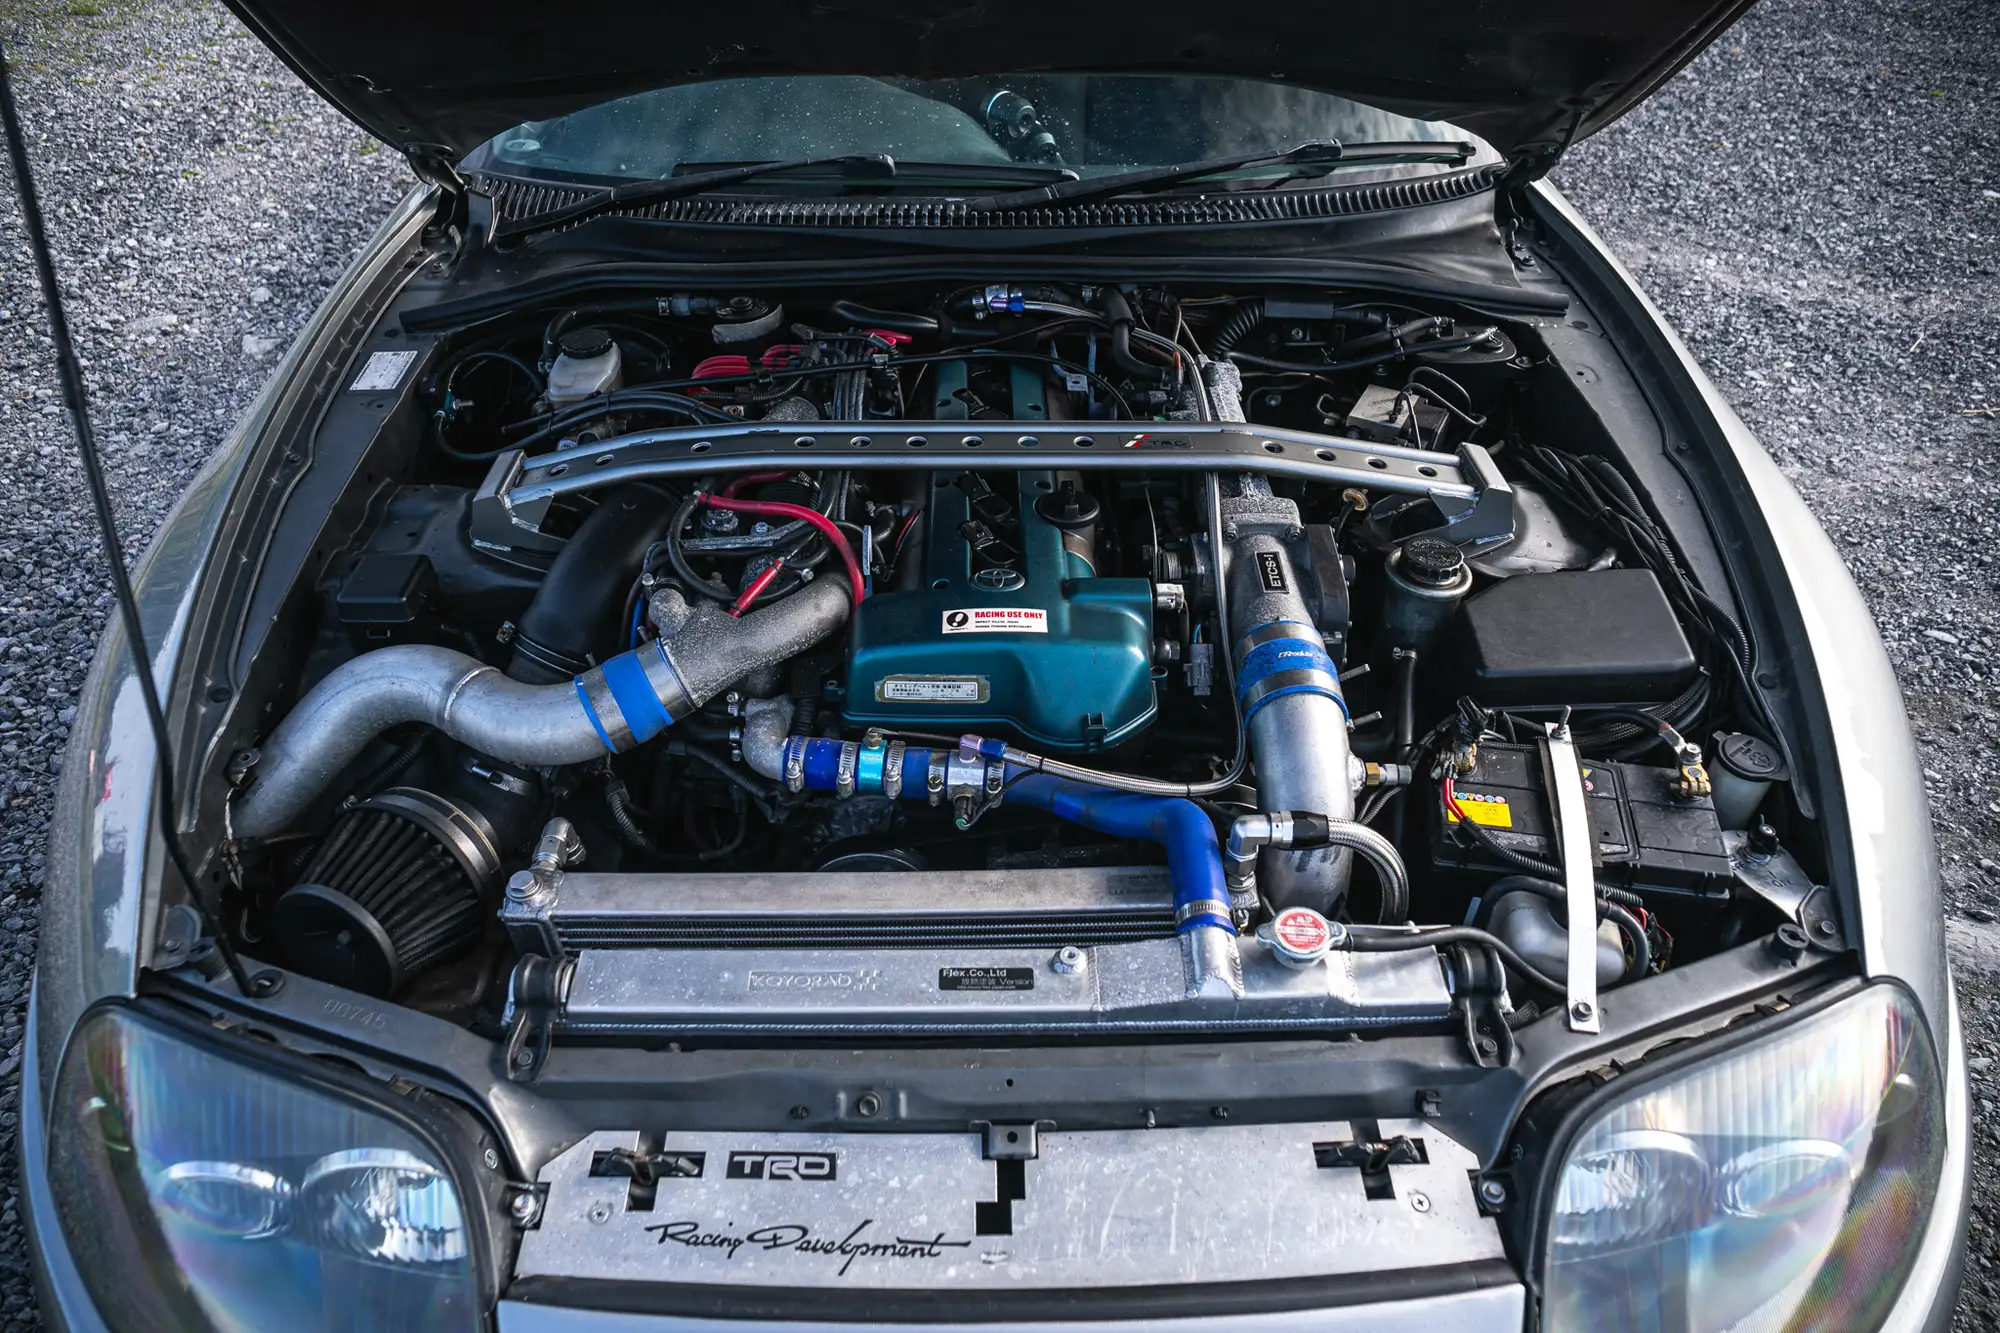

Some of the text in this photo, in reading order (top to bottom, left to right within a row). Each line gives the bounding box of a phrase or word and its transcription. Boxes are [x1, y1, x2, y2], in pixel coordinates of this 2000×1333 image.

[974, 611, 1006, 619] RACING
[752, 974, 852, 988] KOYORAD
[732, 1155, 831, 1181] TRD
[644, 1219, 972, 1276] Racing Development
